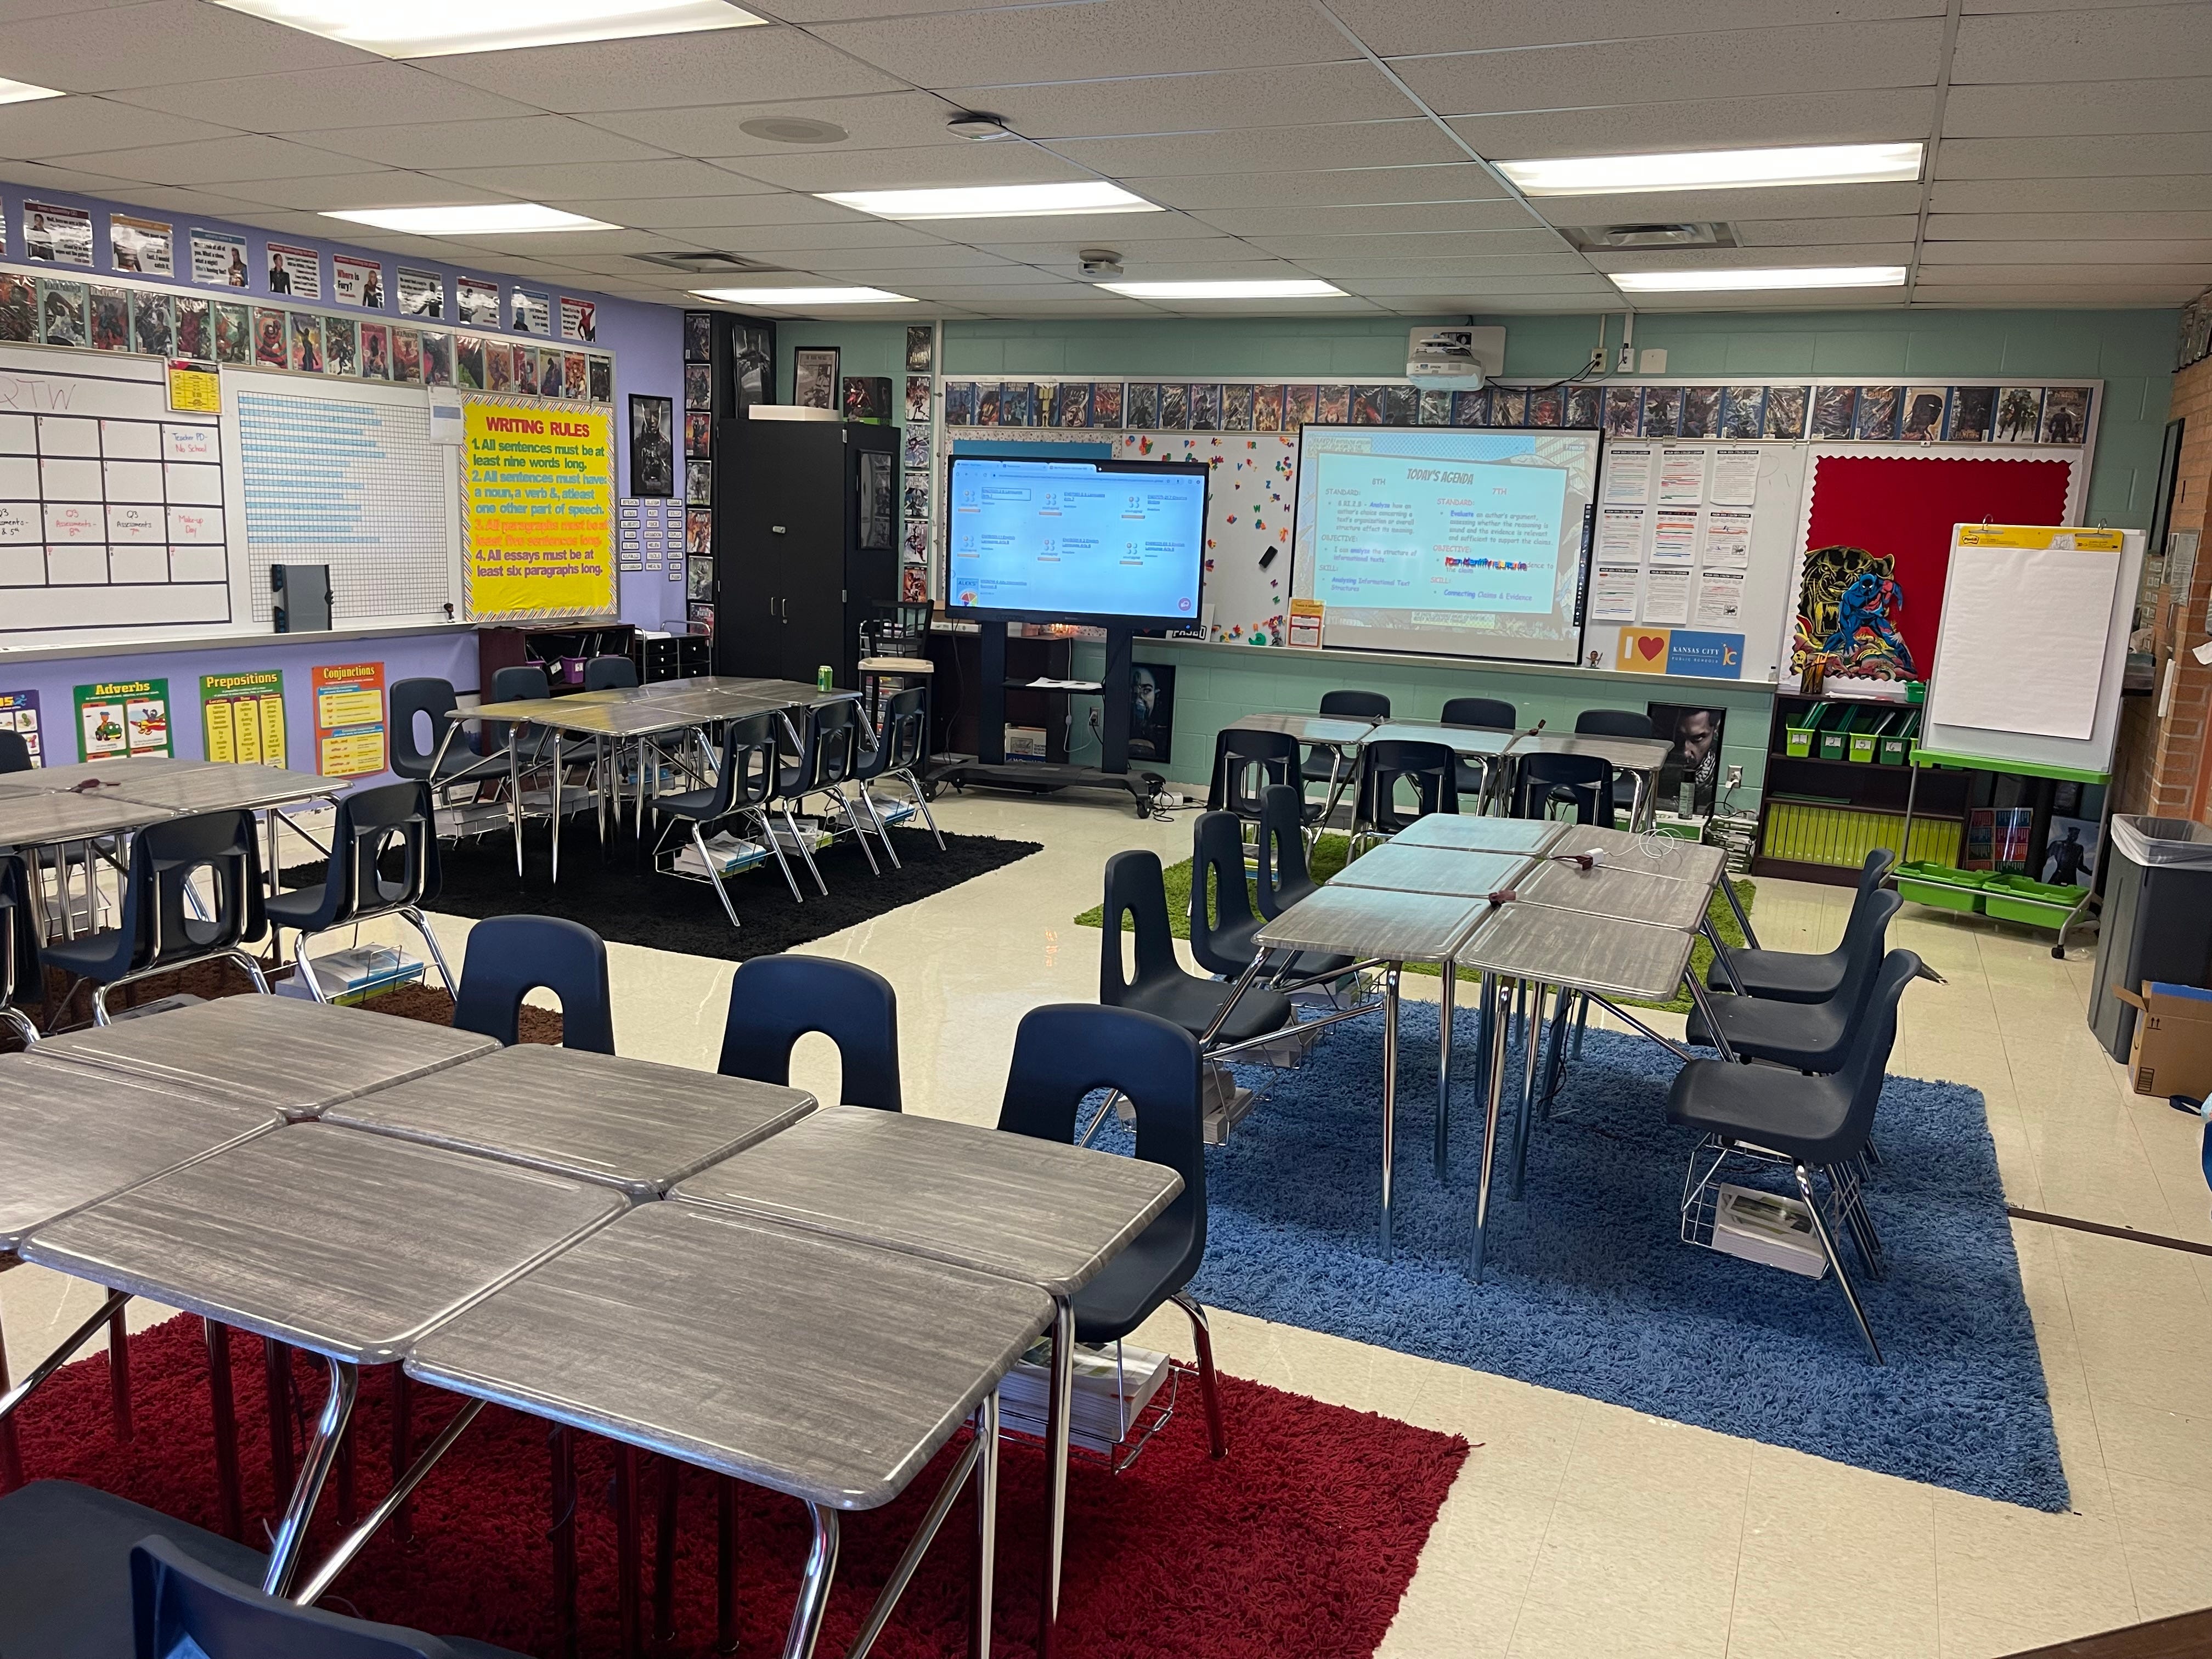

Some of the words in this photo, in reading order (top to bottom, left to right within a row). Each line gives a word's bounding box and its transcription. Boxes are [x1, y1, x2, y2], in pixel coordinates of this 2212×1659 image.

[338, 280, 352, 291] Fury?
[486, 416, 544, 434] WRITING
[550, 422, 589, 438] RULES
[172, 433, 193, 441] Teacher
[176, 444, 185, 452] No
[188, 444, 206, 453] School
[482, 439, 495, 451] All
[499, 442, 552, 454] sentences
[555, 444, 579, 455] must
[582, 445, 593, 455] be
[595, 447, 604, 456] at
[473, 455, 500, 466] least
[504, 456, 526, 467] nine
[529, 458, 560, 468] words
[565, 458, 587, 472] long.
[472, 470, 482, 482] 2.
[484, 471, 497, 483] All
[500, 472, 553, 483] sentences
[556, 473, 580, 484] must
[1407, 469, 1440, 482] TODAY'S
[1441, 472, 1474, 484] AGENDA
[475, 488, 482, 497] a
[515, 489, 521, 498] a
[526, 488, 547, 498] verb
[66, 509, 78, 518] Q3
[127, 510, 139, 518] Q3
[476, 505, 495, 514] one
[500, 504, 527, 514] other
[531, 504, 552, 516] part
[555, 504, 565, 515] of
[568, 505, 604, 517] speech.
[1254, 505, 1260, 513] W
[186, 526, 196, 537] Day
[486, 520, 500, 530] All
[503, 520, 557, 533] paragraphs
[561, 520, 585, 530] must
[476, 535, 503, 546] least
[506, 535, 523, 546] five
[527, 536, 577, 546] sentences
[581, 535, 602, 547] long.
[1433, 545, 1471, 553] OBJECTIVE:
[476, 550, 486, 561] 4.
[488, 550, 501, 561] All
[504, 552, 539, 563] essays
[543, 550, 566, 560] must
[570, 550, 581, 560] be
[585, 549, 594, 559] at
[477, 565, 504, 576] least
[507, 565, 522, 576] six
[524, 566, 578, 578] paragraphs
[582, 564, 602, 576] long.
[1444, 589, 1475, 599] Connecting
[1624, 636, 1633, 658] I
[324, 665, 375, 681] Conjunctions
[206, 673, 278, 689] Prepositions
[95, 682, 150, 695] Adverbs
